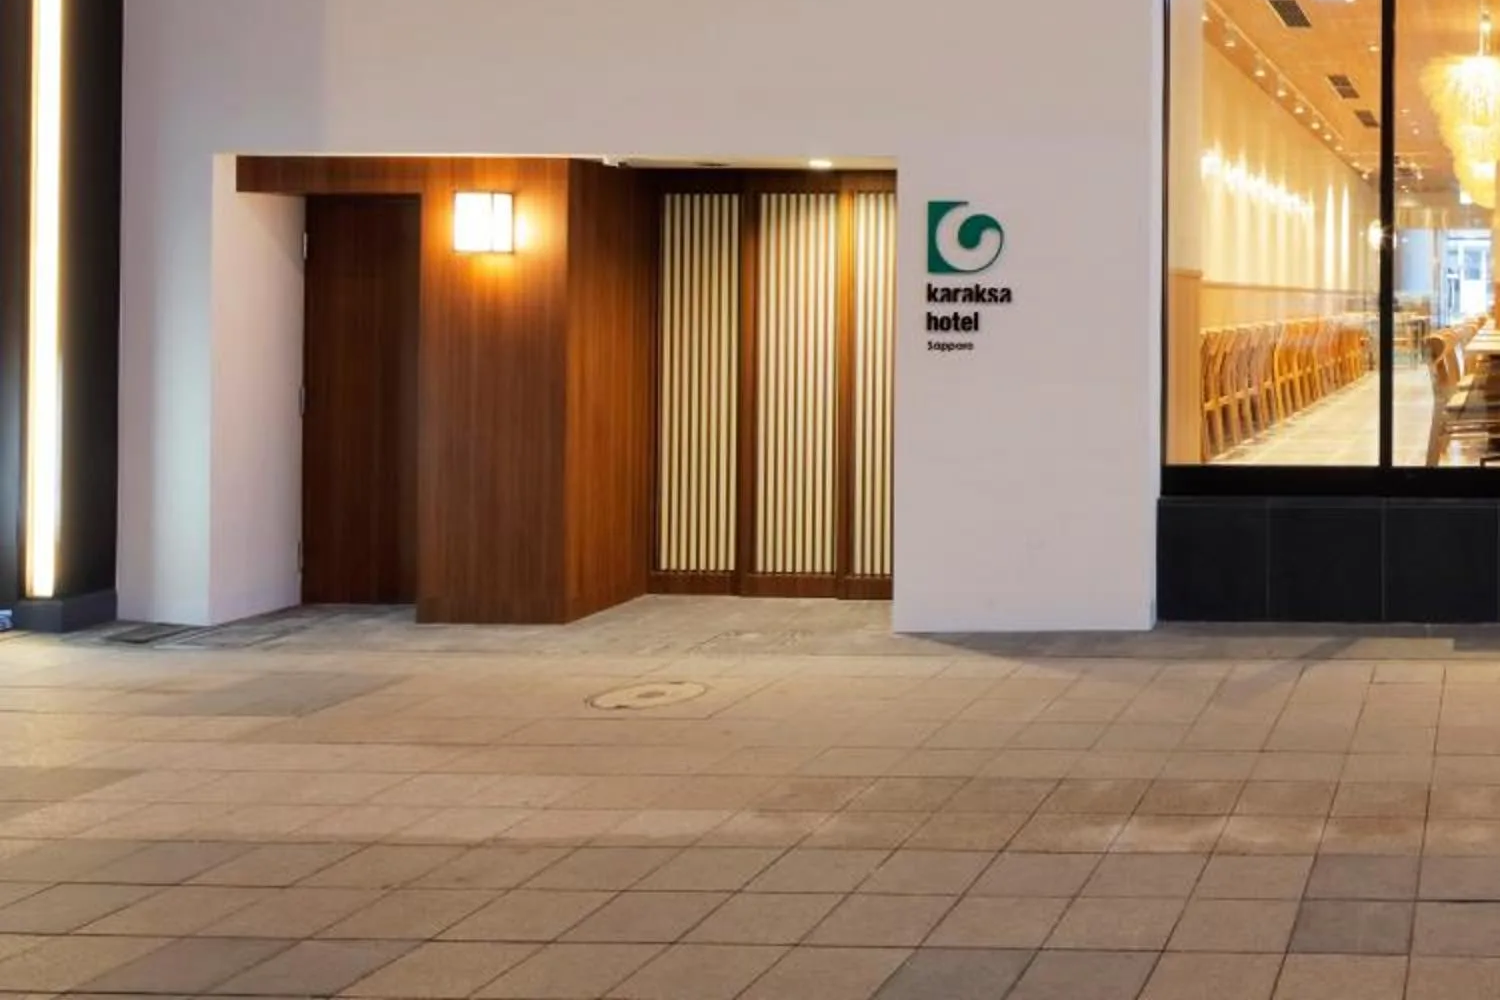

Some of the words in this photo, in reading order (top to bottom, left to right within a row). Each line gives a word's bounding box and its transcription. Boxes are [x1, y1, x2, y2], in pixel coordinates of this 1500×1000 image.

[926, 283, 1012, 303] karaksa
[926, 311, 979, 332] hotel
[927, 340, 974, 351] Sapporo
